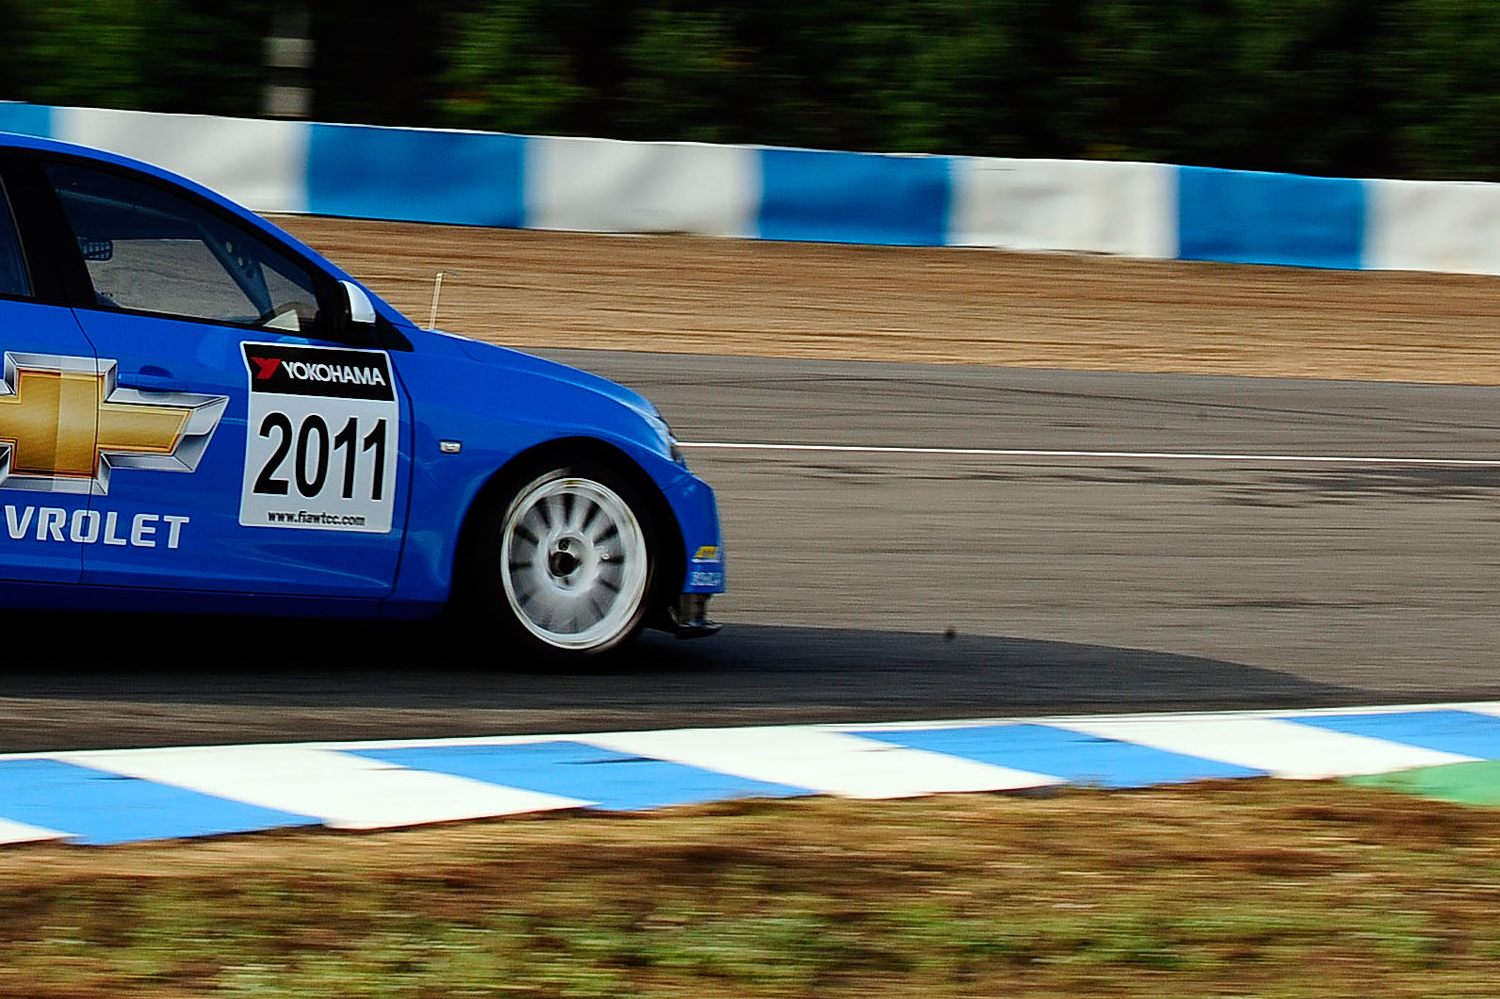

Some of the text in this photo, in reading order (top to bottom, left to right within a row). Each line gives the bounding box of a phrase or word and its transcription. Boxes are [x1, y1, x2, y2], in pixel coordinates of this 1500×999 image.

[281, 361, 386, 386] YOKOHAMA
[253, 411, 387, 500] 2011
[267, 510, 366, 526] www.fiawtcc.com
